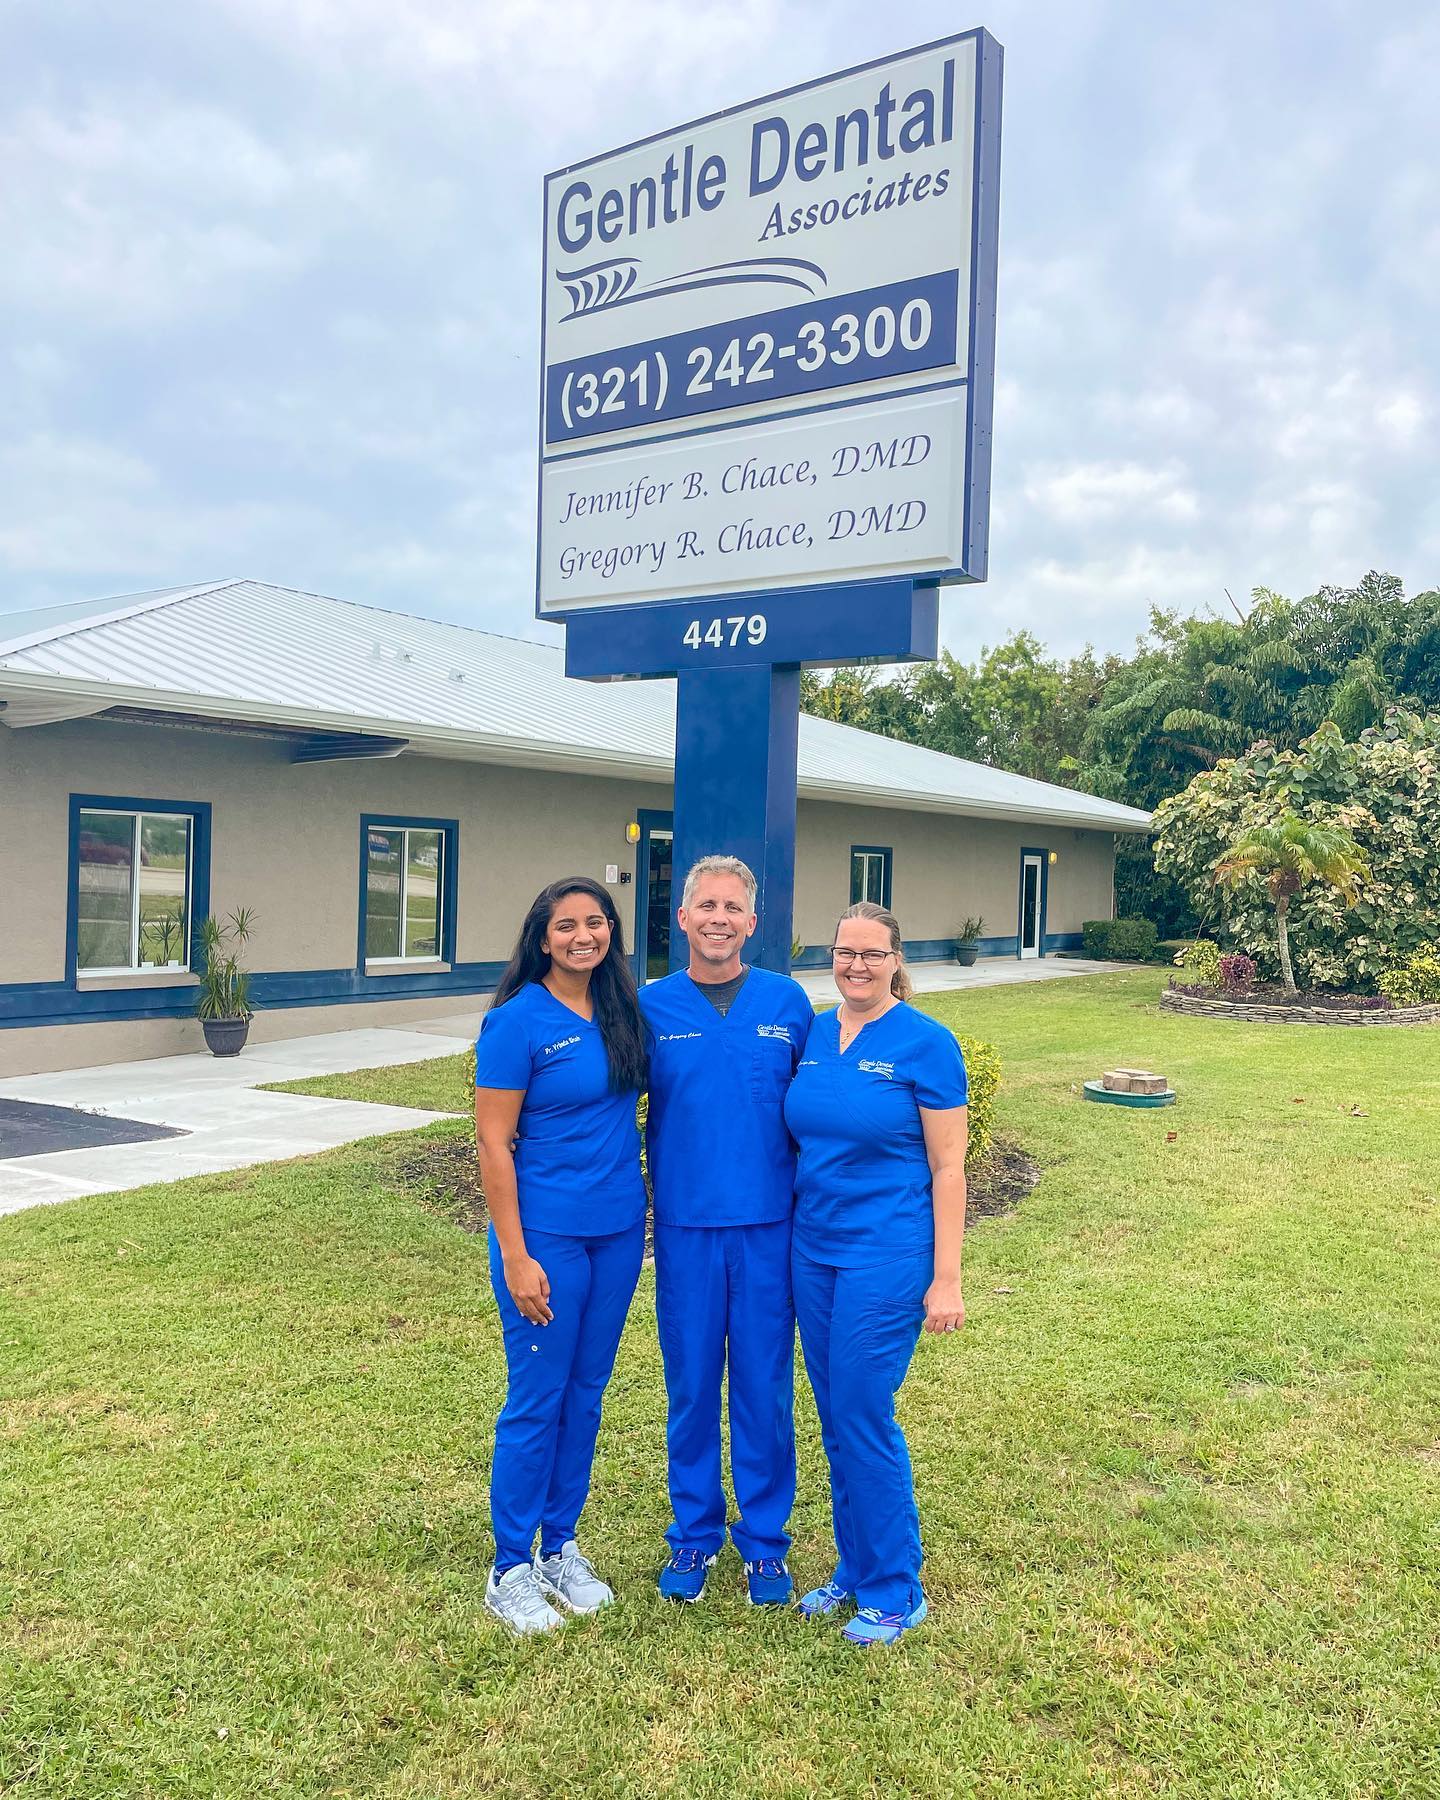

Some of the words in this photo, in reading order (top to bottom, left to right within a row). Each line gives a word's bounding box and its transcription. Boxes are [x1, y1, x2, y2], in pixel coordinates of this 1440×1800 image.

[557, 144, 727, 254] Gentle
[749, 58, 956, 198] Dental
[758, 168, 950, 242] Associates
[561, 351, 670, 428] (321)
[685, 298, 932, 396] 242-3300
[559, 474, 674, 524] Jennifer
[683, 470, 708, 500] B.
[721, 457, 818, 494] Chace,
[832, 433, 932, 478] DMD
[558, 539, 667, 580] Gregory
[677, 531, 705, 560] R.
[717, 517, 814, 554] Chace,
[828, 499, 927, 541] DMD
[682, 614, 768, 650] 4479
